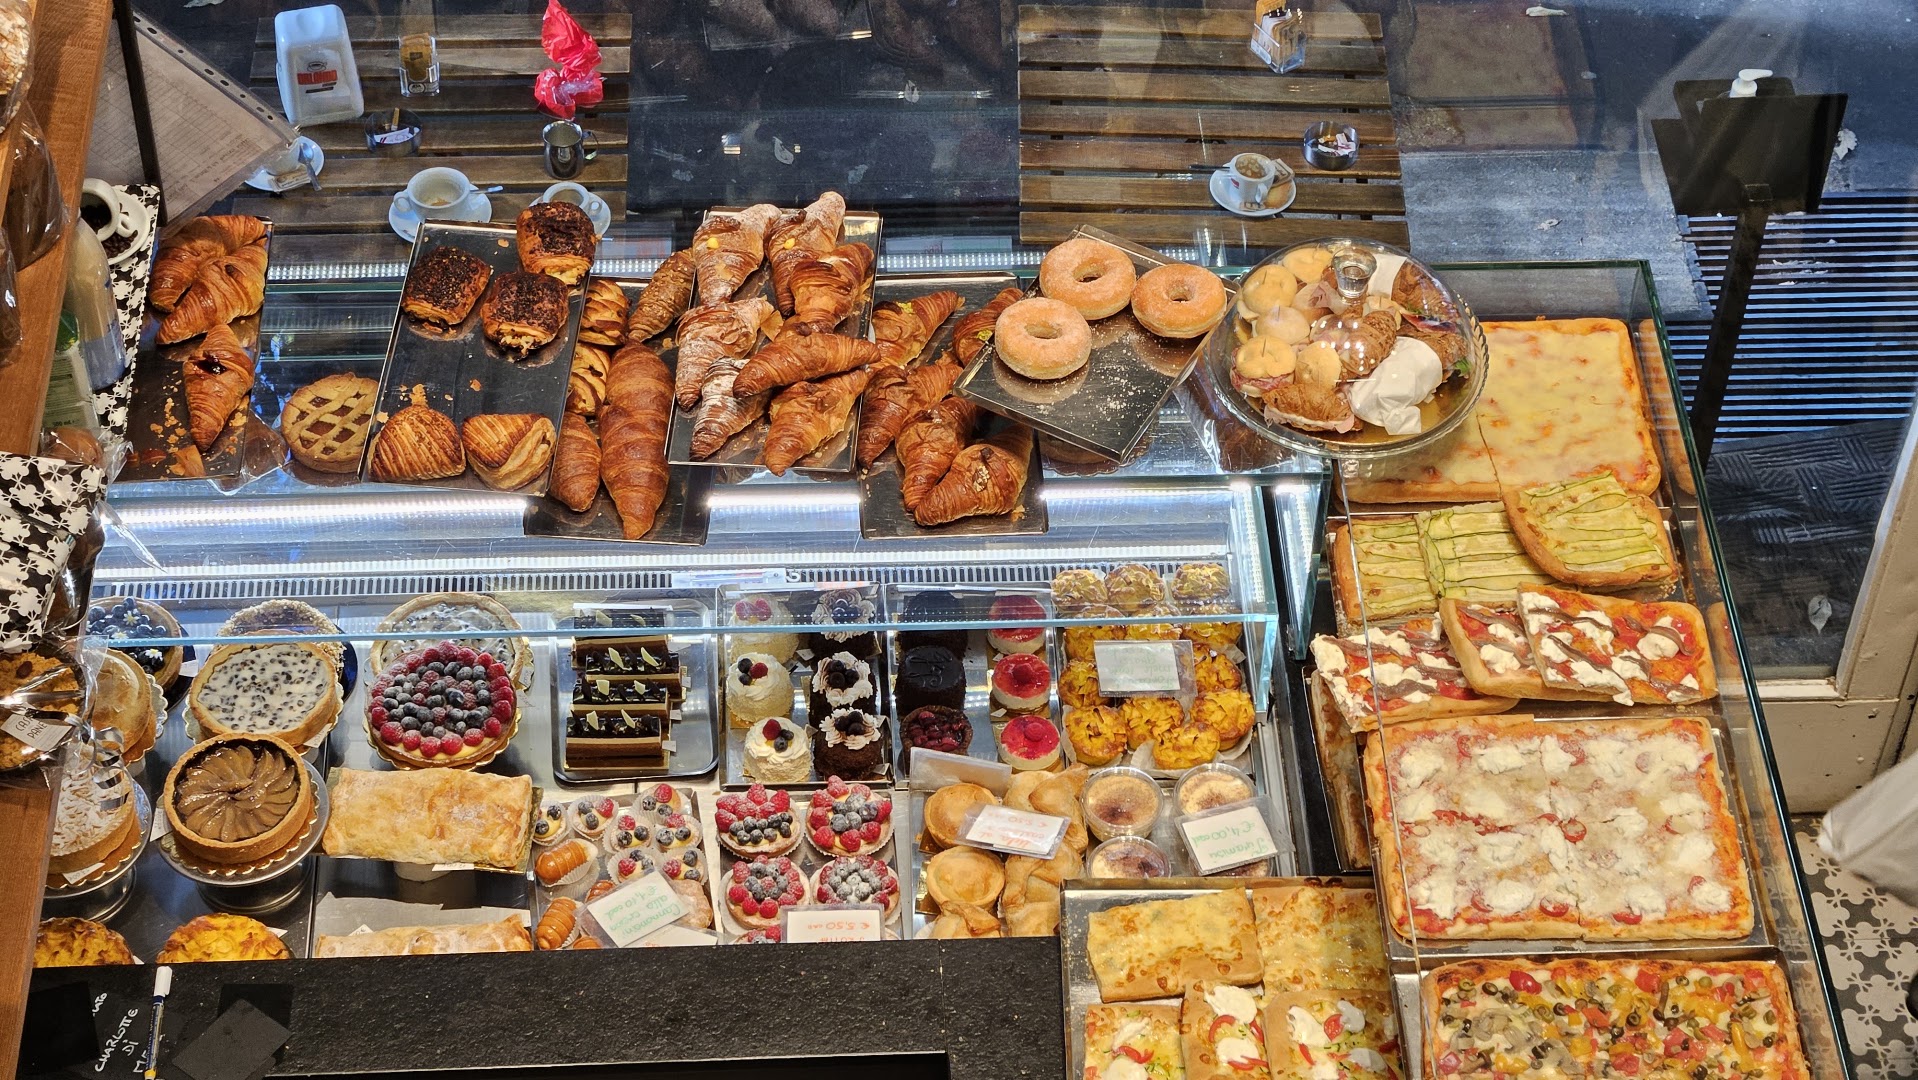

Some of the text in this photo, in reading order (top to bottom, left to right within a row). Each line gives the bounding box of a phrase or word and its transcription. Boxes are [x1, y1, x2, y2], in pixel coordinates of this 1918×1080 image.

[27, 721, 47, 739] PANE
[646, 895, 668, 909] alla
[826, 921, 856, 931] 5,50
[95, 1008, 138, 1072] CHARLOTTE
